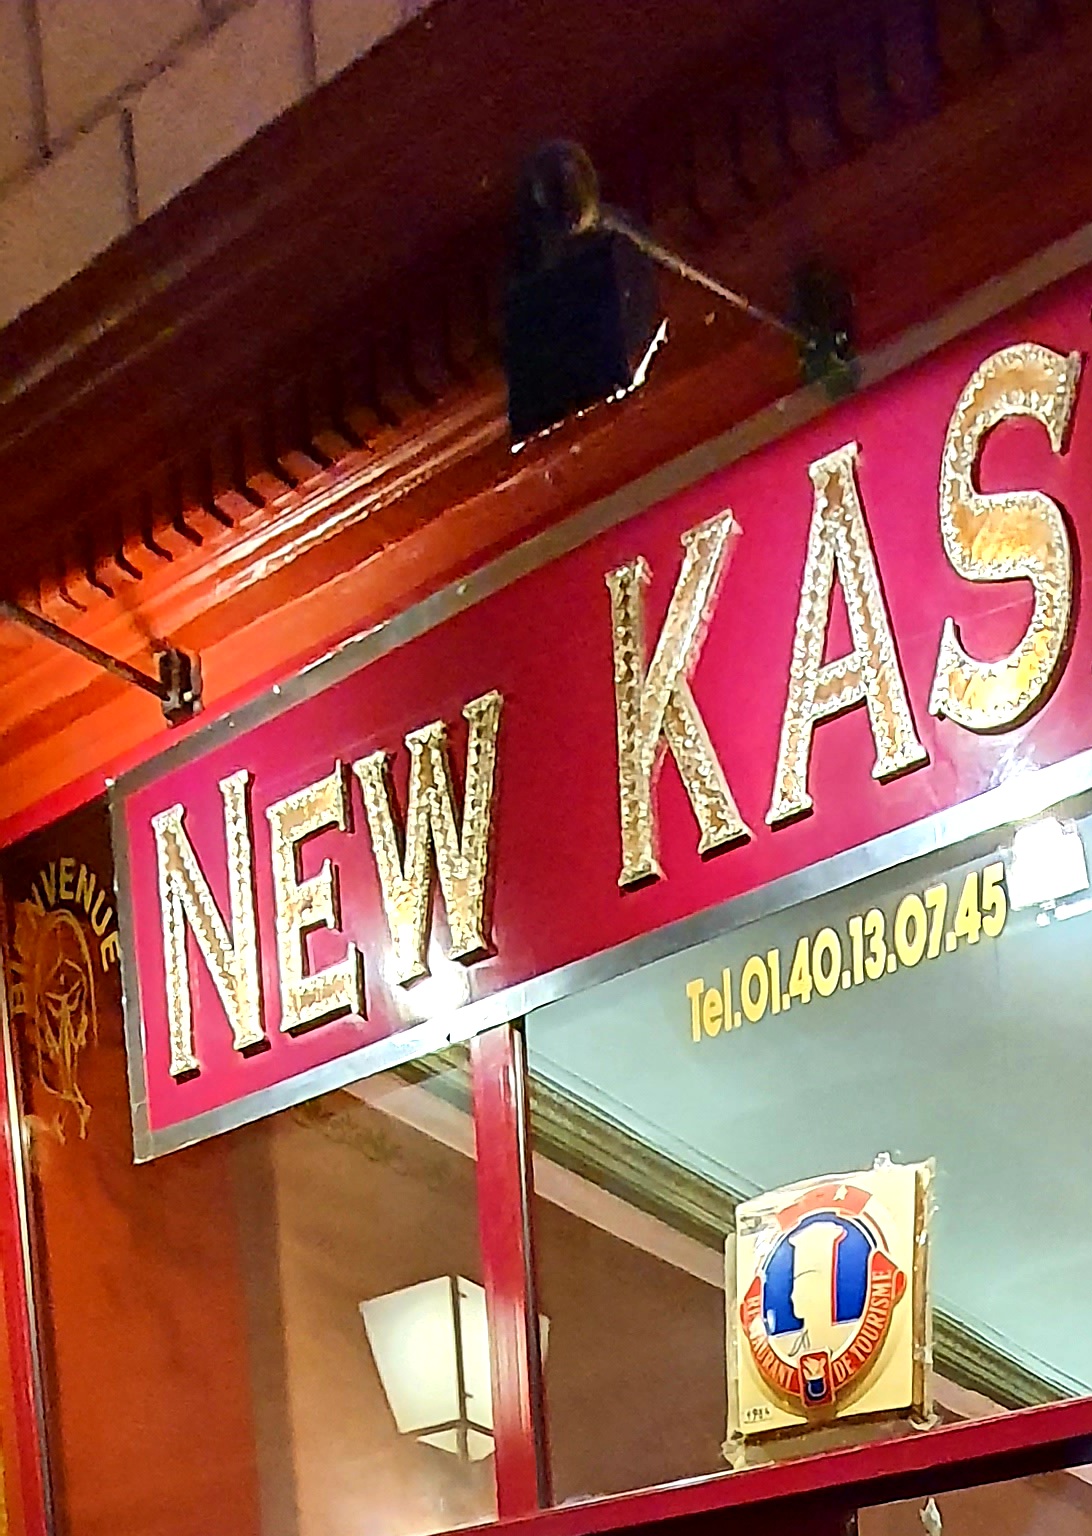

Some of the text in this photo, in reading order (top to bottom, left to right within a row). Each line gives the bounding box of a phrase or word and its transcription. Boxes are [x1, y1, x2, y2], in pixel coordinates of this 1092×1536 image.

[152, 690, 503, 1080] NEW
[686, 860, 1007, 1042] Tel.01.40.13.07.45
[852, 1267, 894, 1365] TOURISME
